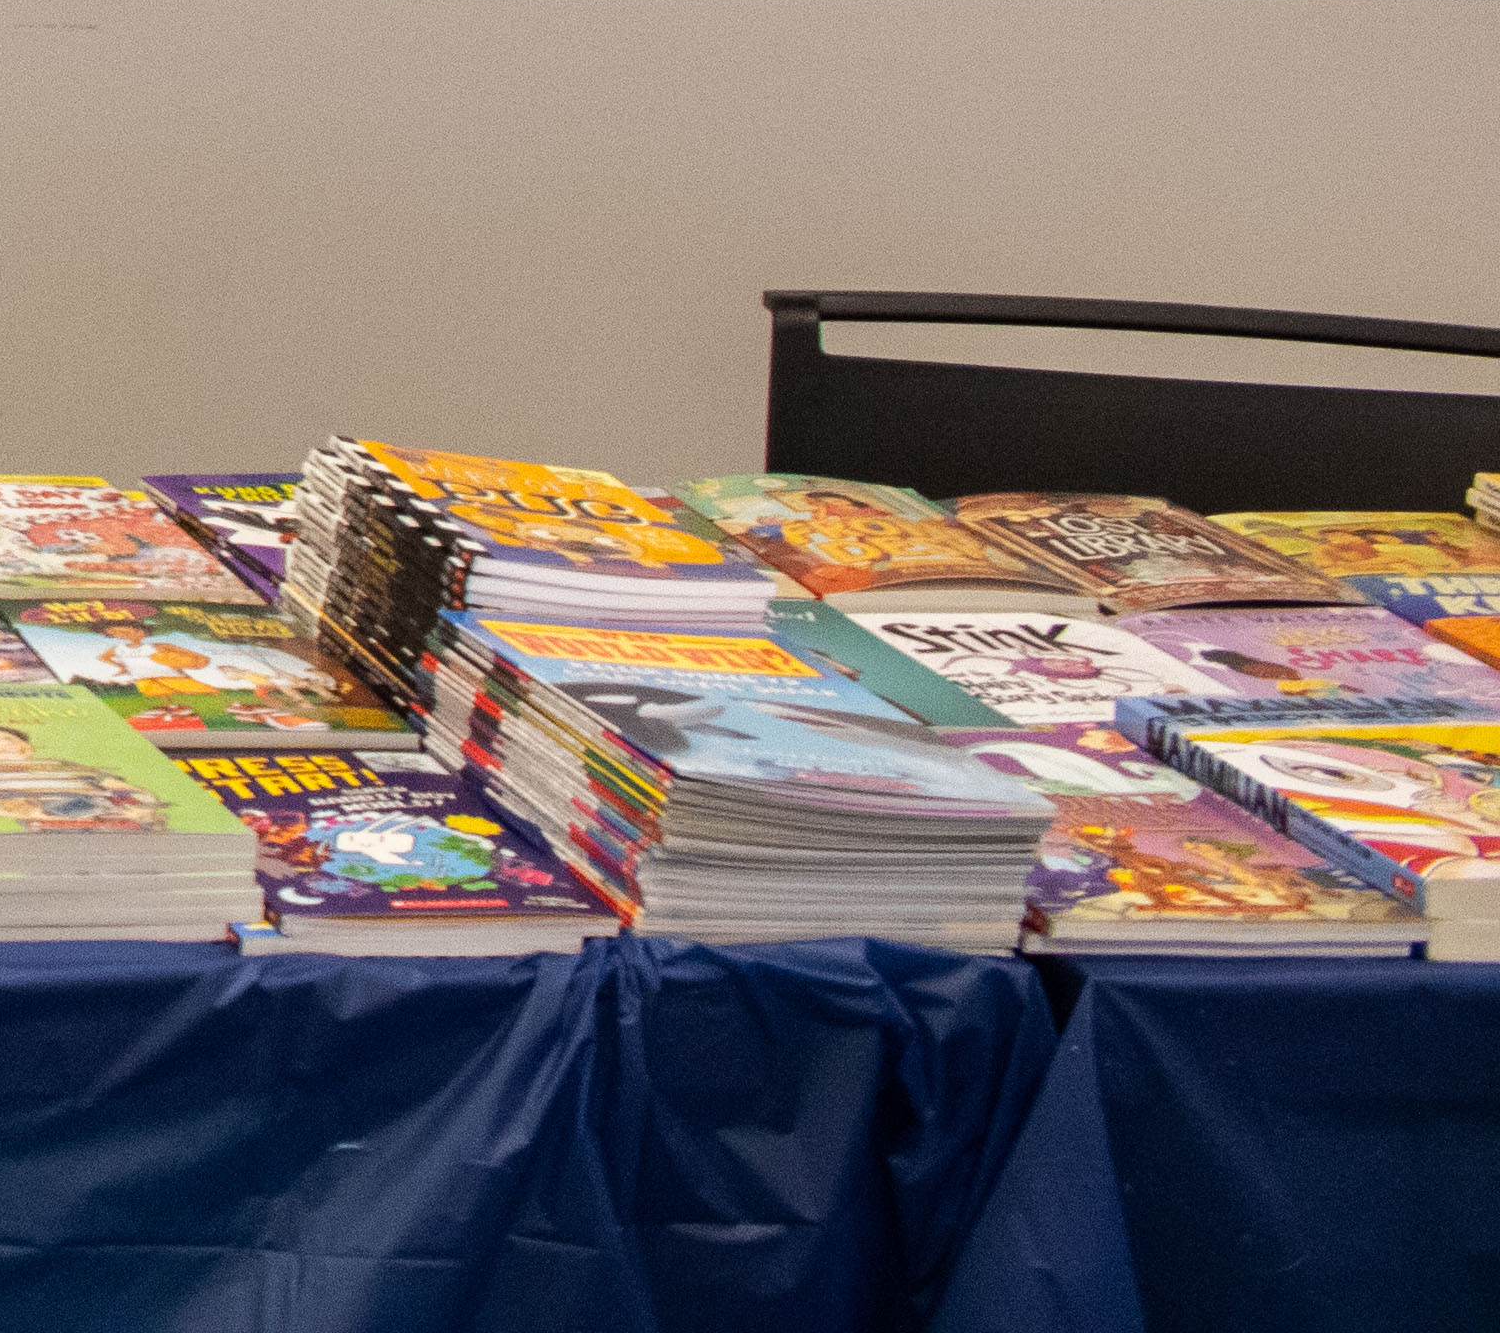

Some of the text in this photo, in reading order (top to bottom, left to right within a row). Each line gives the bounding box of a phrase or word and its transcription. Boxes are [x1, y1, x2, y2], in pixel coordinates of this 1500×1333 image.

[438, 479, 646, 526] PUG
[1040, 515, 1148, 534] LOST
[1051, 534, 1226, 560] LIBRARY
[500, 628, 802, 674] WOULD WIN?
[881, 623, 1123, 655] Stink
